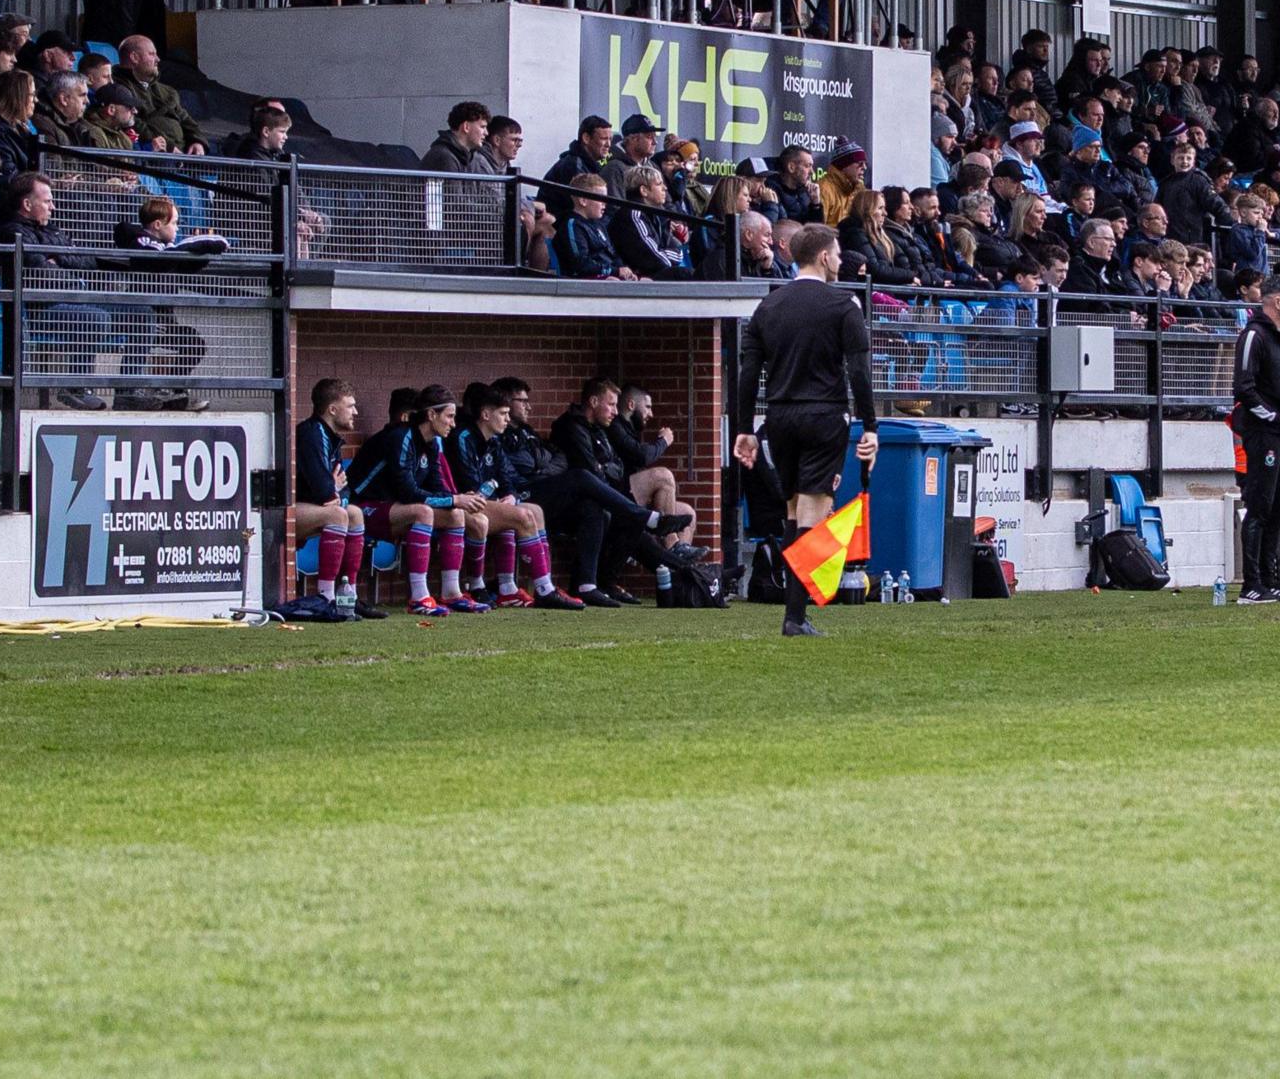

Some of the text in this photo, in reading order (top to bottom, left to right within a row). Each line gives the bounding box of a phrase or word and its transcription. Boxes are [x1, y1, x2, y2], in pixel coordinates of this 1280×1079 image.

[608, 34, 770, 146] KHS
[783, 70, 854, 100] khsgroup.co.uk
[783, 131, 827, 153] 01492 516
[104, 439, 241, 502] HAFOD
[1001, 444, 1019, 474] Ltd
[994, 486, 1021, 504] Solutions
[102, 510, 241, 532] ELECTRICAL & SECURITY
[157, 544, 241, 567] 07881 348960
[156, 569, 241, 584] info@hafodelectrical.co.uk
